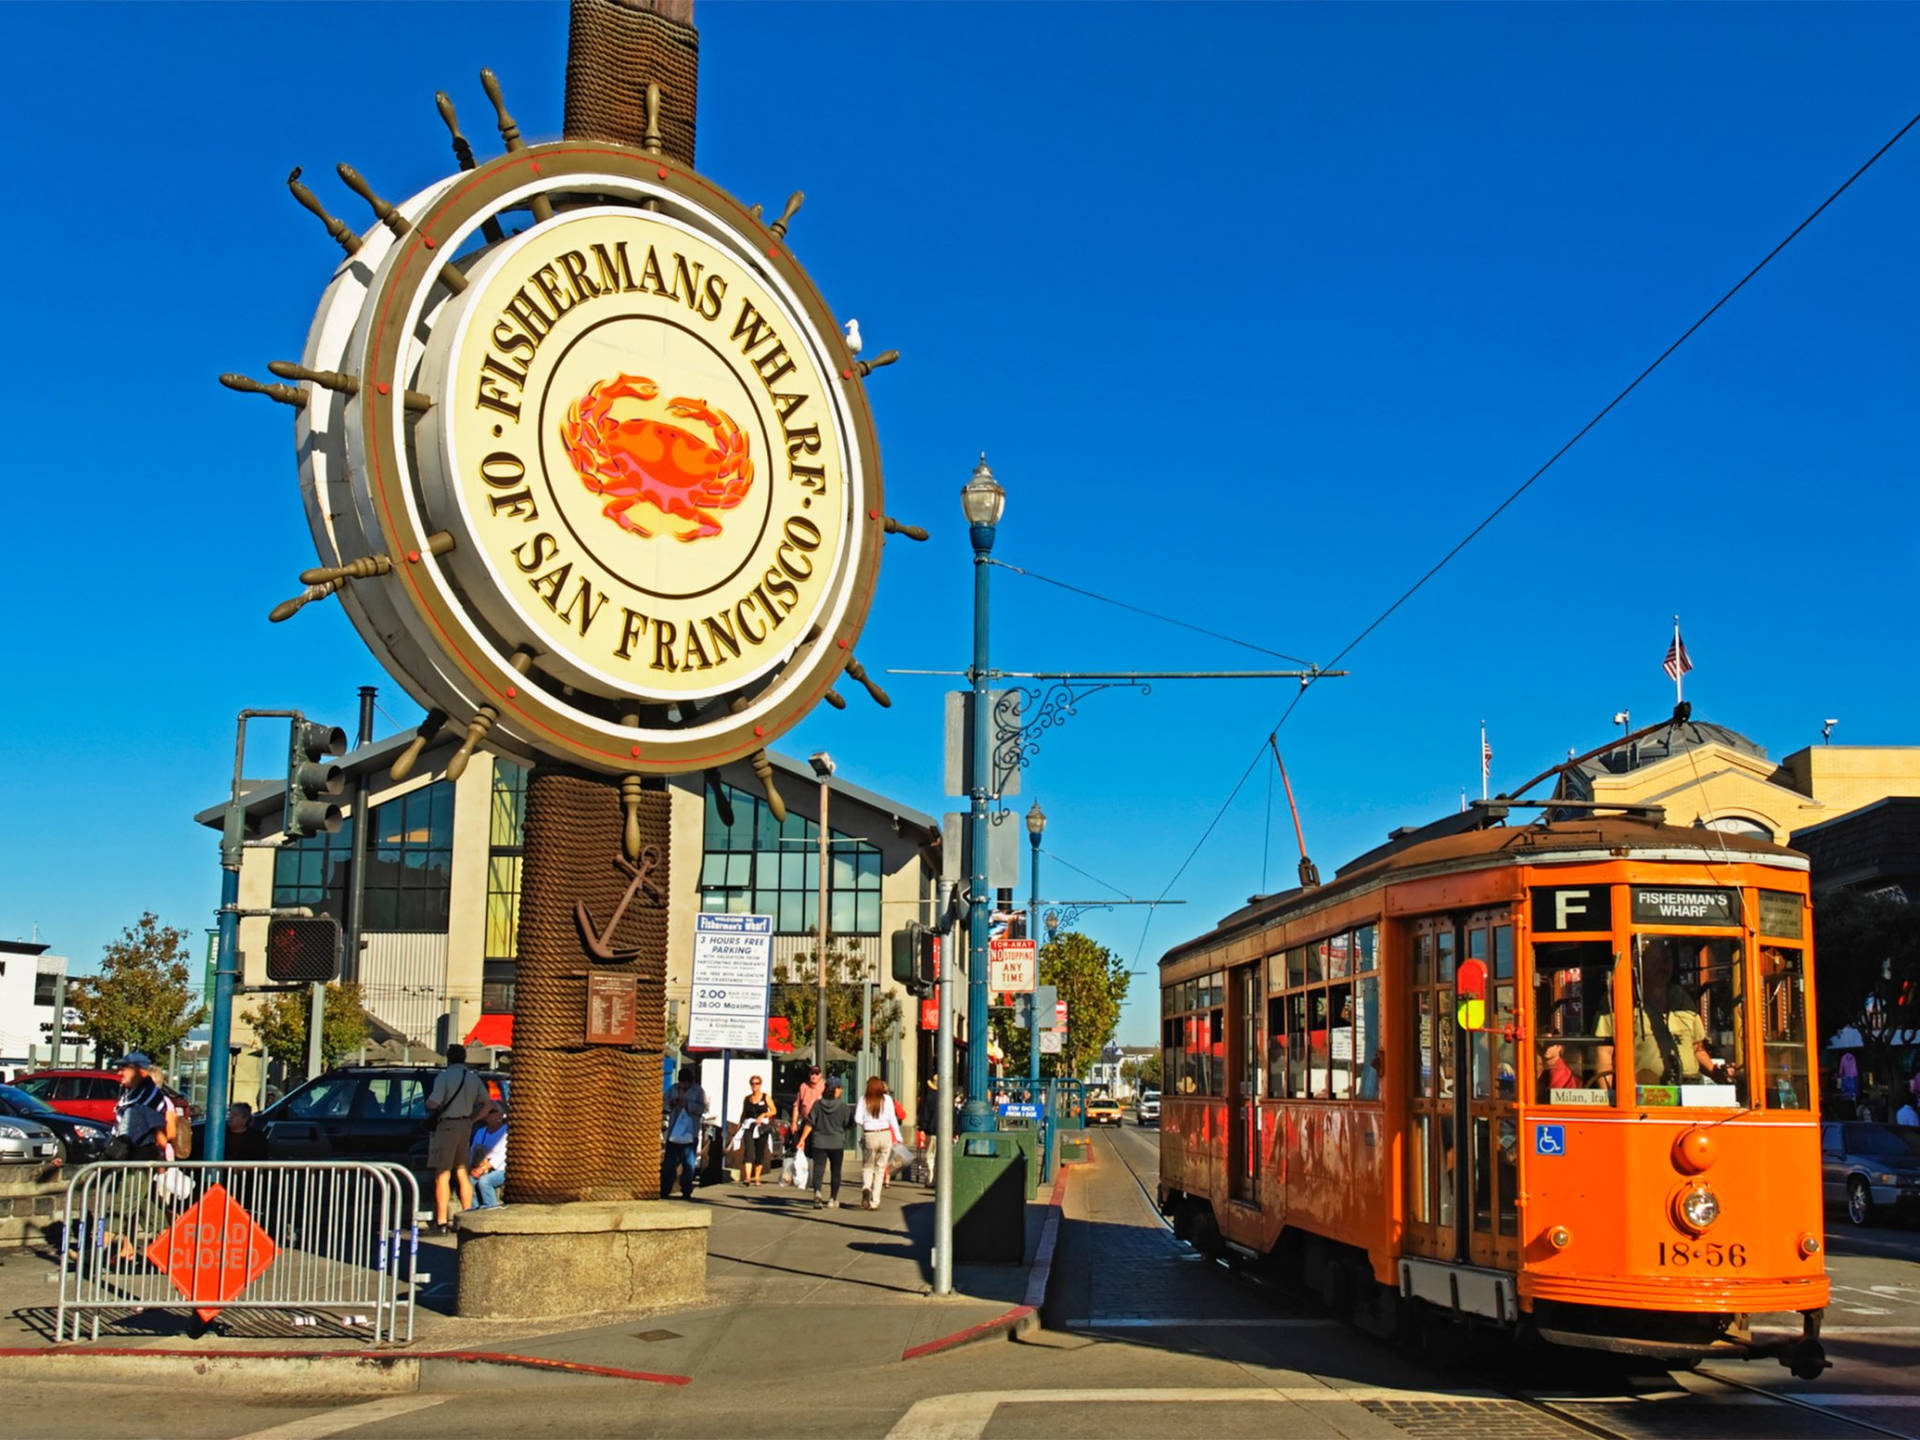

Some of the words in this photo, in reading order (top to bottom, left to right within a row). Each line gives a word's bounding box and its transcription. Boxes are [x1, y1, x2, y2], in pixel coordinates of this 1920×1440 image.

[475, 241, 728, 424] FISHERMANS
[729, 297, 827, 496] WHARF
[481, 450, 540, 524] OF
[511, 531, 610, 637] SAN
[614, 514, 822, 672] FRANCISCO
[1638, 892, 1728, 907] FISHERMAN'S
[1554, 890, 1590, 930] F
[1659, 904, 1708, 918] WHARF
[700, 936, 706, 944] 3
[709, 937, 741, 945] HOURS
[744, 938, 764, 946] FREE
[711, 946, 752, 954] PARKING
[990, 950, 1003, 961] NO
[1003, 951, 1033, 961] STOPPING
[1003, 963, 1022, 972] ANY
[1002, 973, 1023, 983] TIME
[1591, 1090, 1609, 1104] Ital
[183, 1223, 247, 1245] ROAD
[171, 1247, 259, 1270] CLOSED
